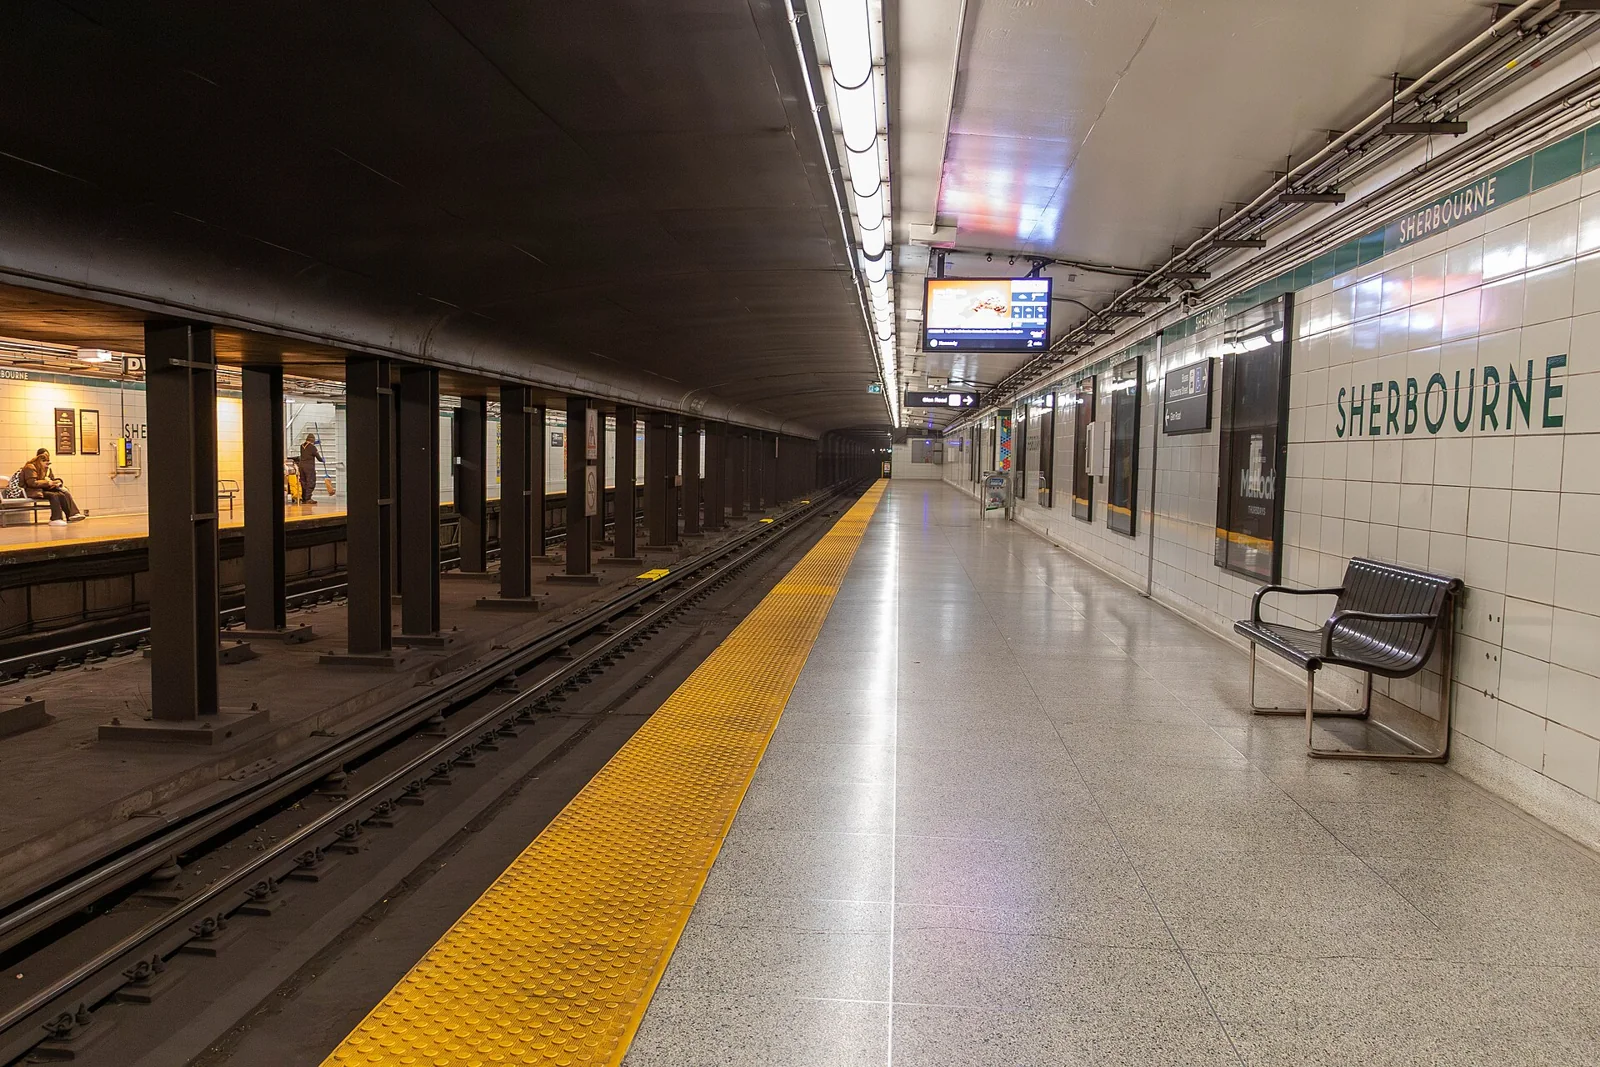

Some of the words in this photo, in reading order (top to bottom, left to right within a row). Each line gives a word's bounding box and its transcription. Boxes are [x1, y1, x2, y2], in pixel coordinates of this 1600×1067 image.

[1399, 176, 1498, 244] SHERBOURNE
[1335, 353, 1568, 439] SHERBOURNE
[124, 423, 147, 439] SHE
